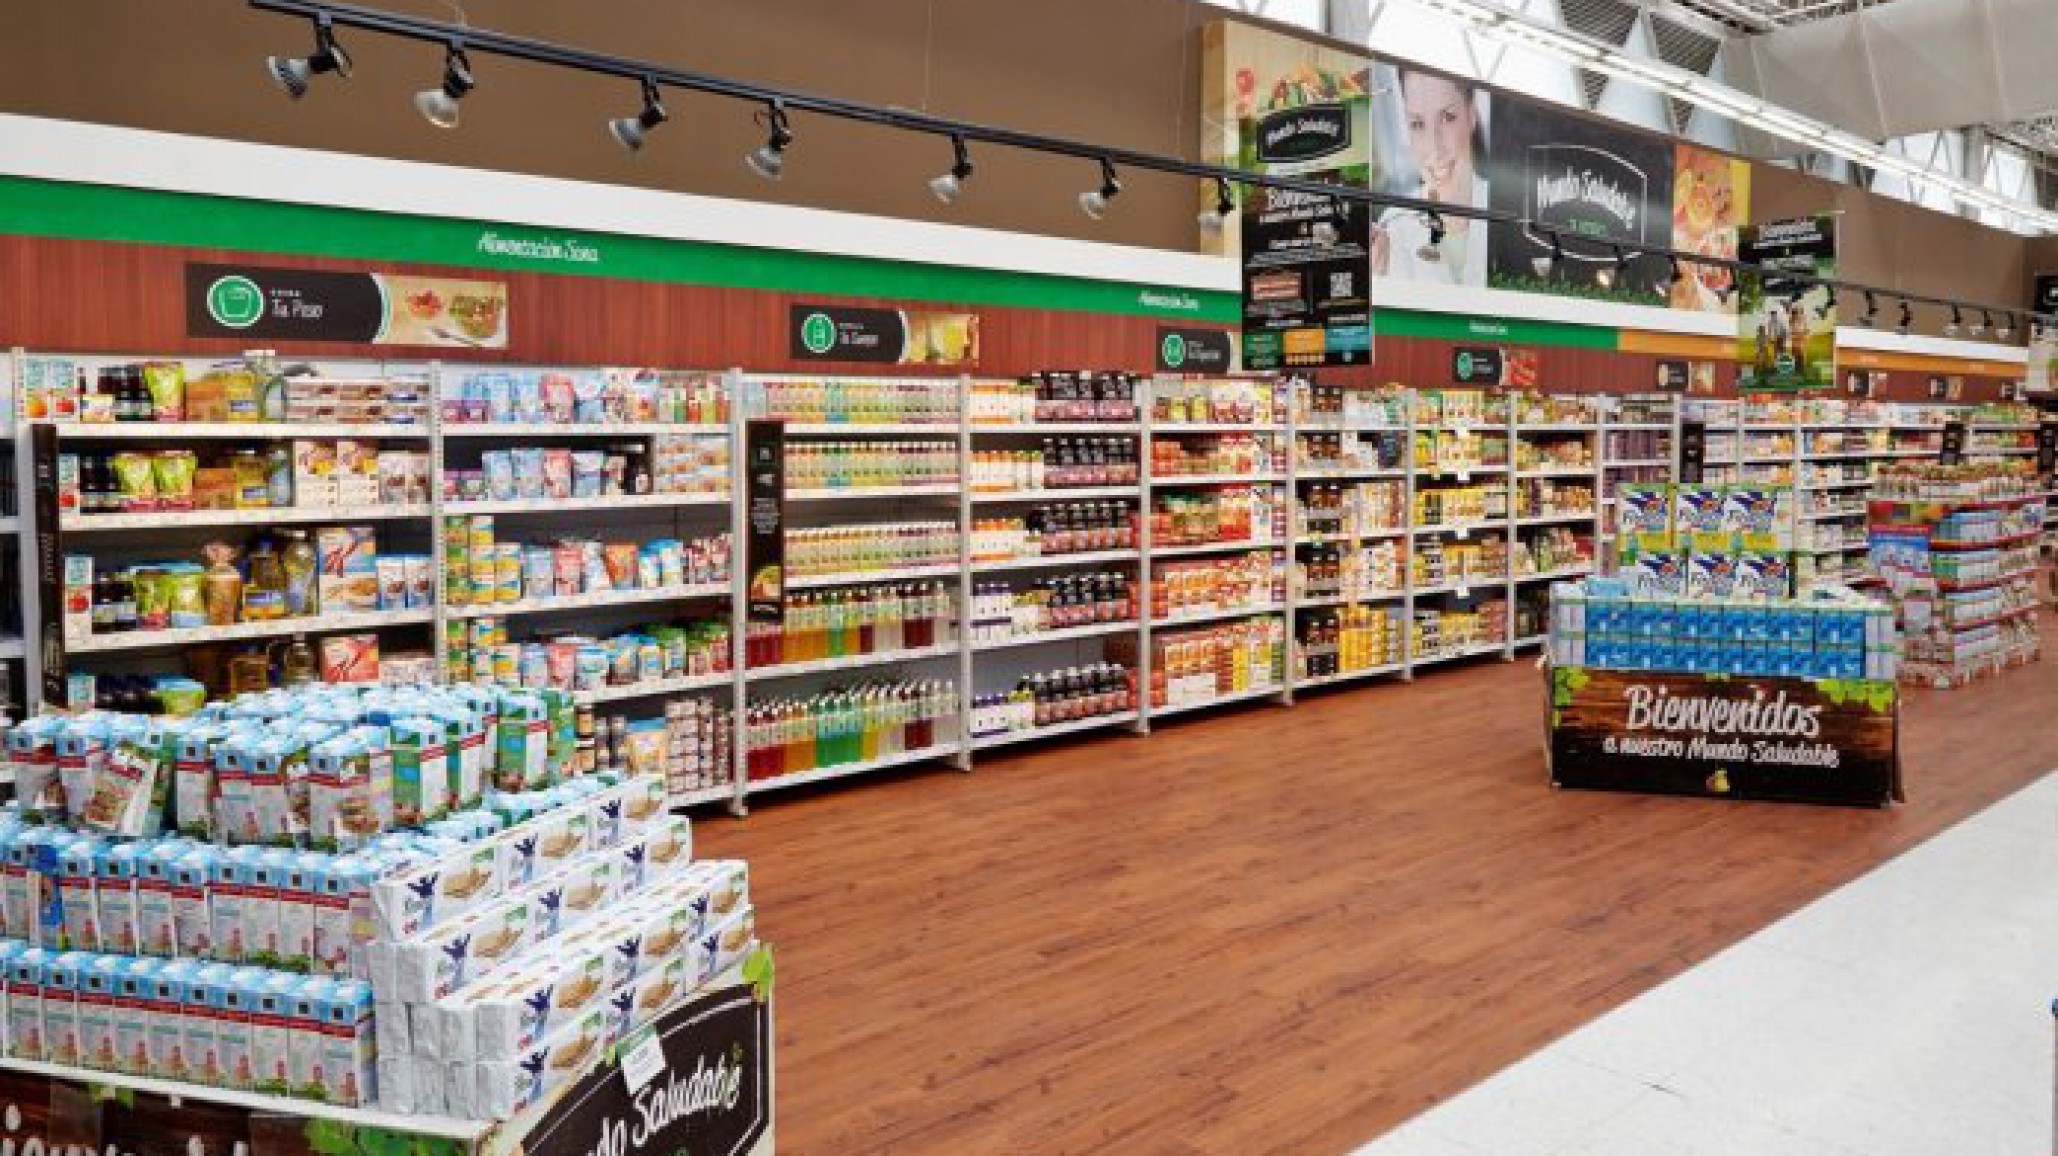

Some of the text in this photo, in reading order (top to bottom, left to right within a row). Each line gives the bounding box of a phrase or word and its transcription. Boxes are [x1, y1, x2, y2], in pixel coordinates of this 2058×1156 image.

[1624, 684, 1822, 738] Bienvenidos
[1602, 736, 1840, 769] a nuestro Mundo Saludable
[632, 1052, 743, 1147] Saludable
